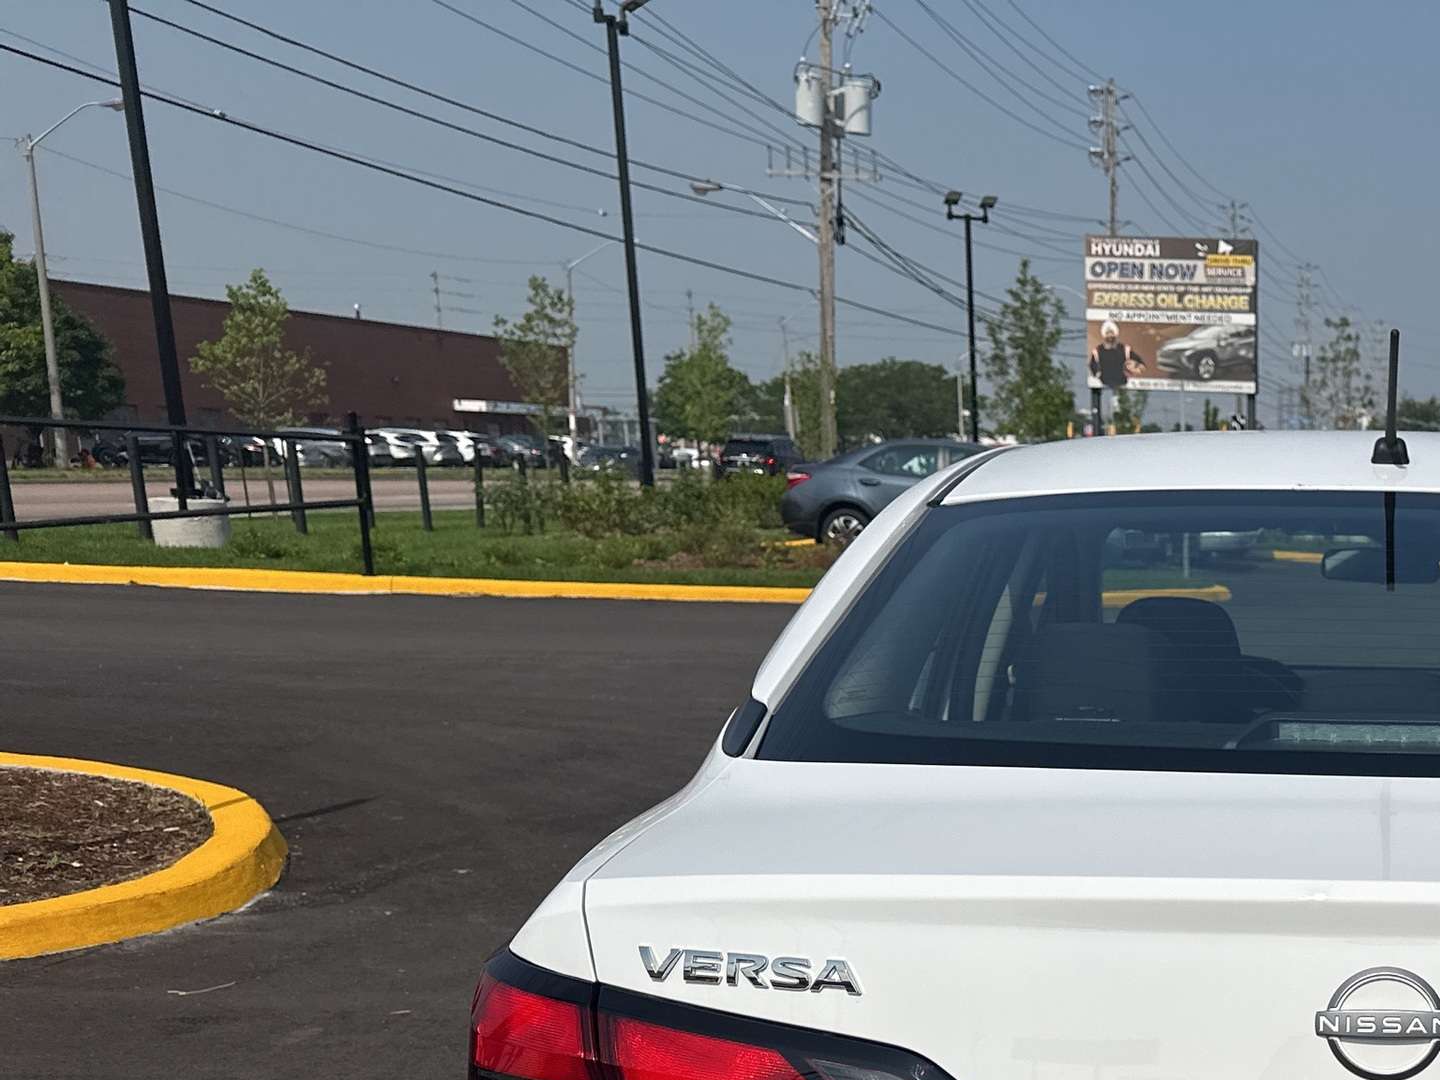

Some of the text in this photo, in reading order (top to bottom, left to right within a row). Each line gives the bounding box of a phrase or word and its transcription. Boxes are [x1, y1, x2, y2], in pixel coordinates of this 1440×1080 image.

[1091, 243, 1160, 257] HYUNDAI
[1090, 261, 1197, 280] OPEN NOW
[1093, 292, 1250, 310] EXPRESS OIL CHANGE
[638, 945, 862, 996] VERSA
